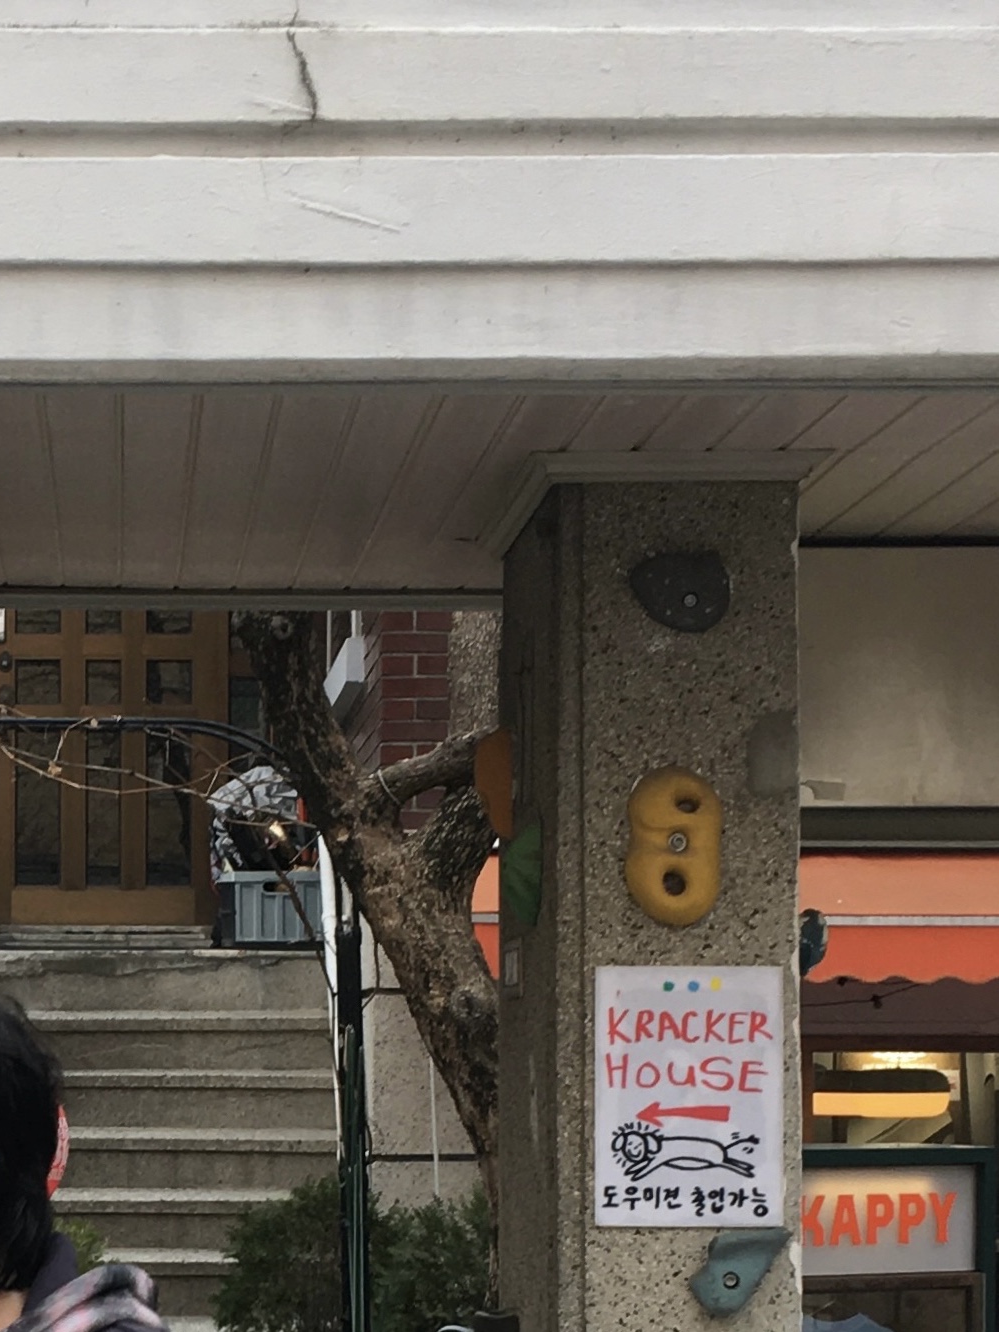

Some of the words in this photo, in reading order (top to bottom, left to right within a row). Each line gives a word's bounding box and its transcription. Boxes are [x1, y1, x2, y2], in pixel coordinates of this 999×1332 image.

[607, 1006, 774, 1046] KRACKER
[601, 1185, 683, 1211] 도우미견
[800, 1191, 958, 1247] KAPPY
